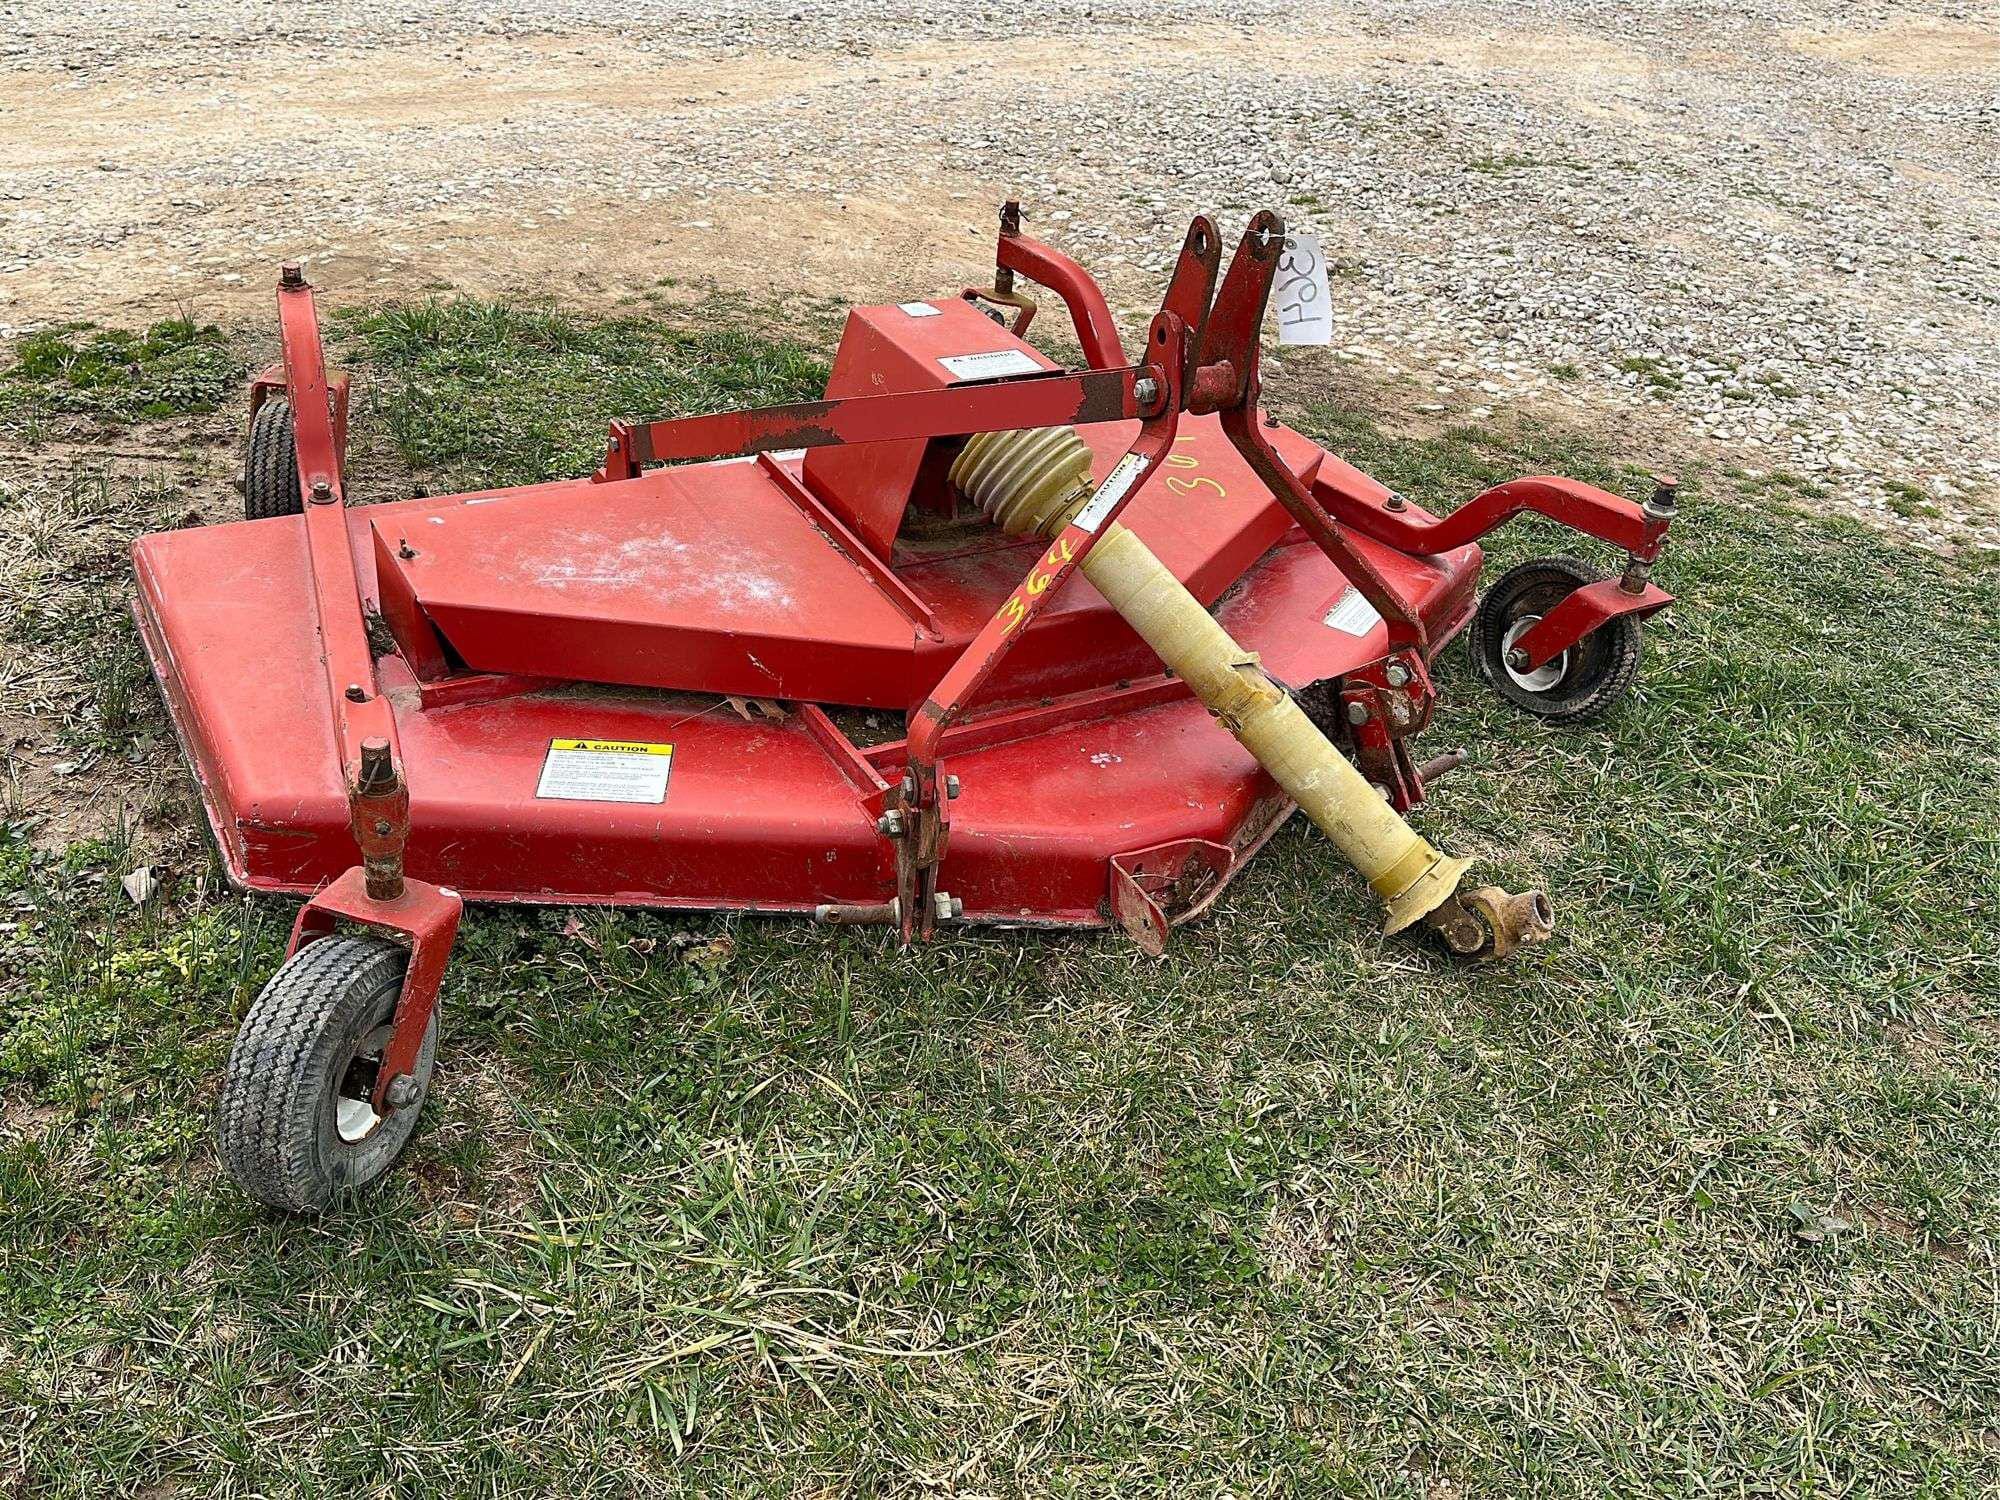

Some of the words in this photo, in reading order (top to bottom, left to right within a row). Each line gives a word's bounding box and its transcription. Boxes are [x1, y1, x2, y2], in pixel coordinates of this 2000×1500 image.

[1278, 249, 1322, 325] 364
[1095, 463, 1126, 502] CAUTION
[996, 538, 1078, 635] 364
[594, 744, 648, 753] CAUTION
